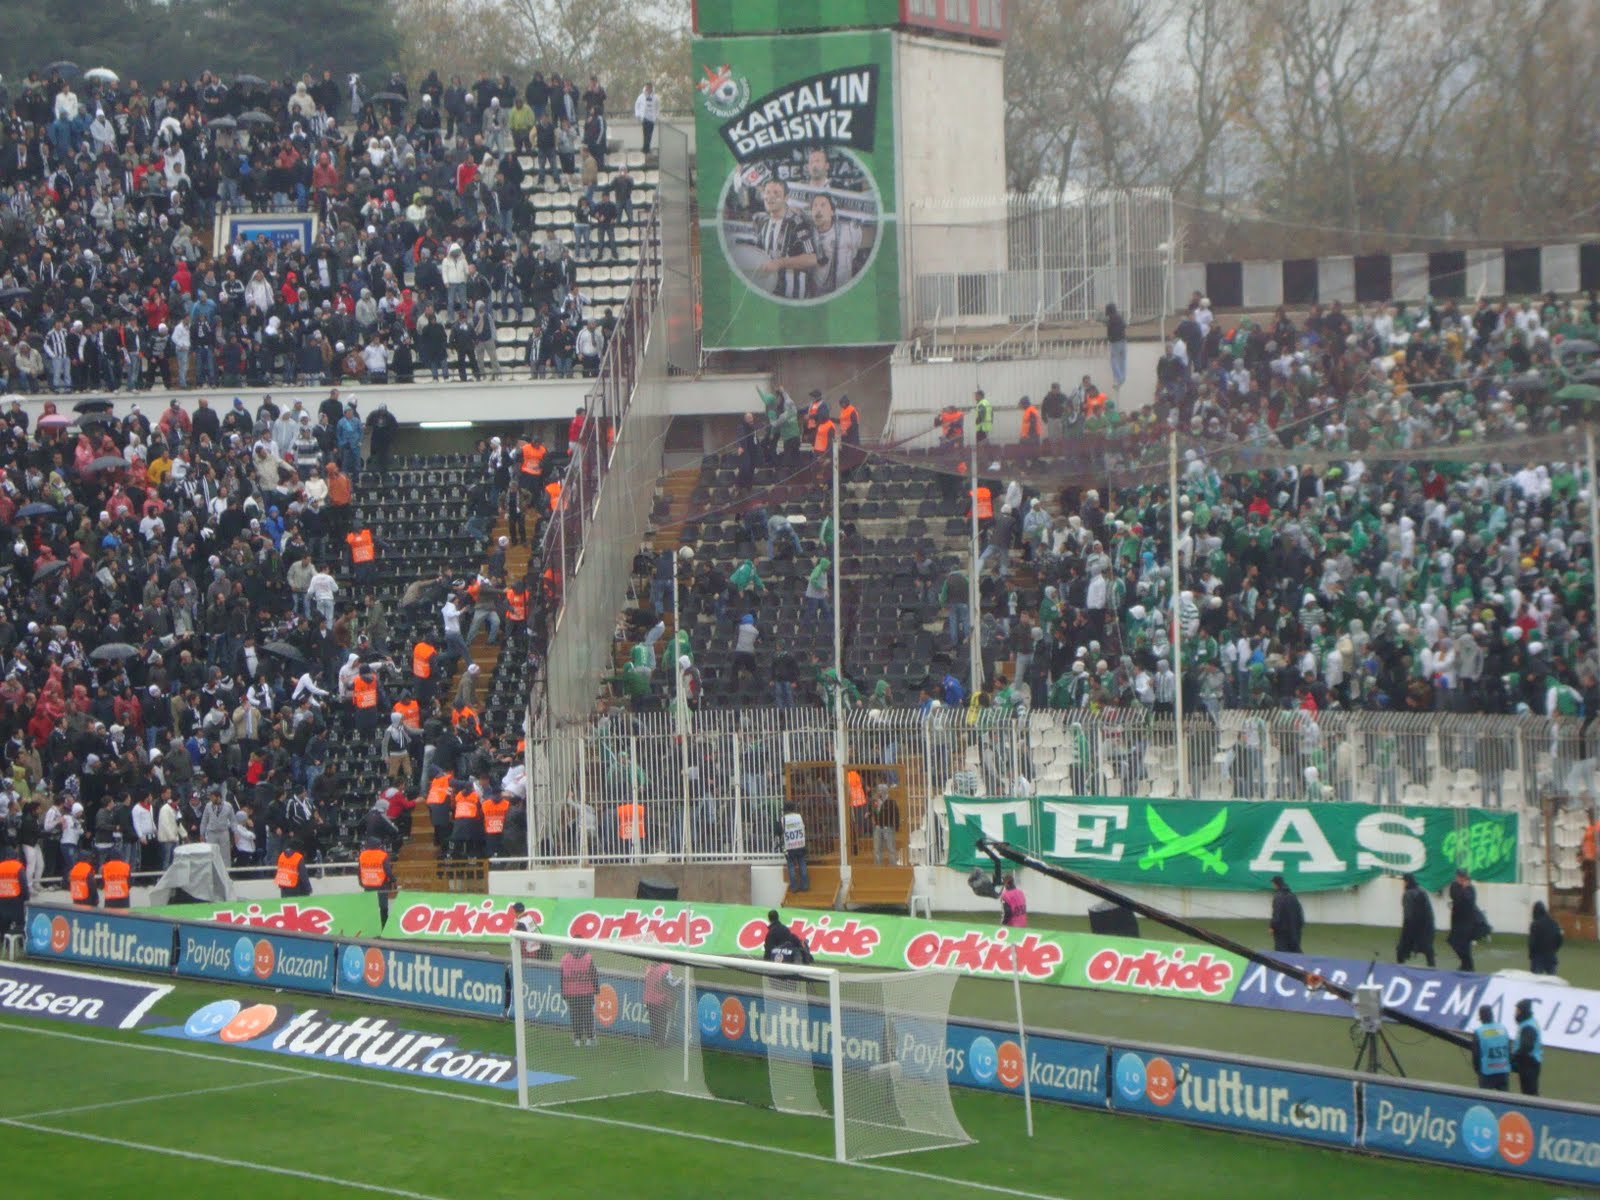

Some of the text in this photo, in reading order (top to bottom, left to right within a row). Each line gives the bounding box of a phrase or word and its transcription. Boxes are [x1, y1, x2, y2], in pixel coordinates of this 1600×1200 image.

[737, 110, 852, 155] DELİSİYİZ
[72, 919, 170, 967] tuttur.com
[186, 938, 231, 971] Paylaş
[277, 947, 328, 979] kazan!
[737, 915, 880, 959] Okide
[388, 951, 502, 1004] tuttur.com
[272, 1009, 512, 1083] tuttur.com
[901, 1034, 964, 1074] Paylaş
[1030, 1053, 1099, 1093] kazan!
[1179, 1063, 1347, 1133] tuttur.com
[1376, 1100, 1457, 1148] Paylaş
